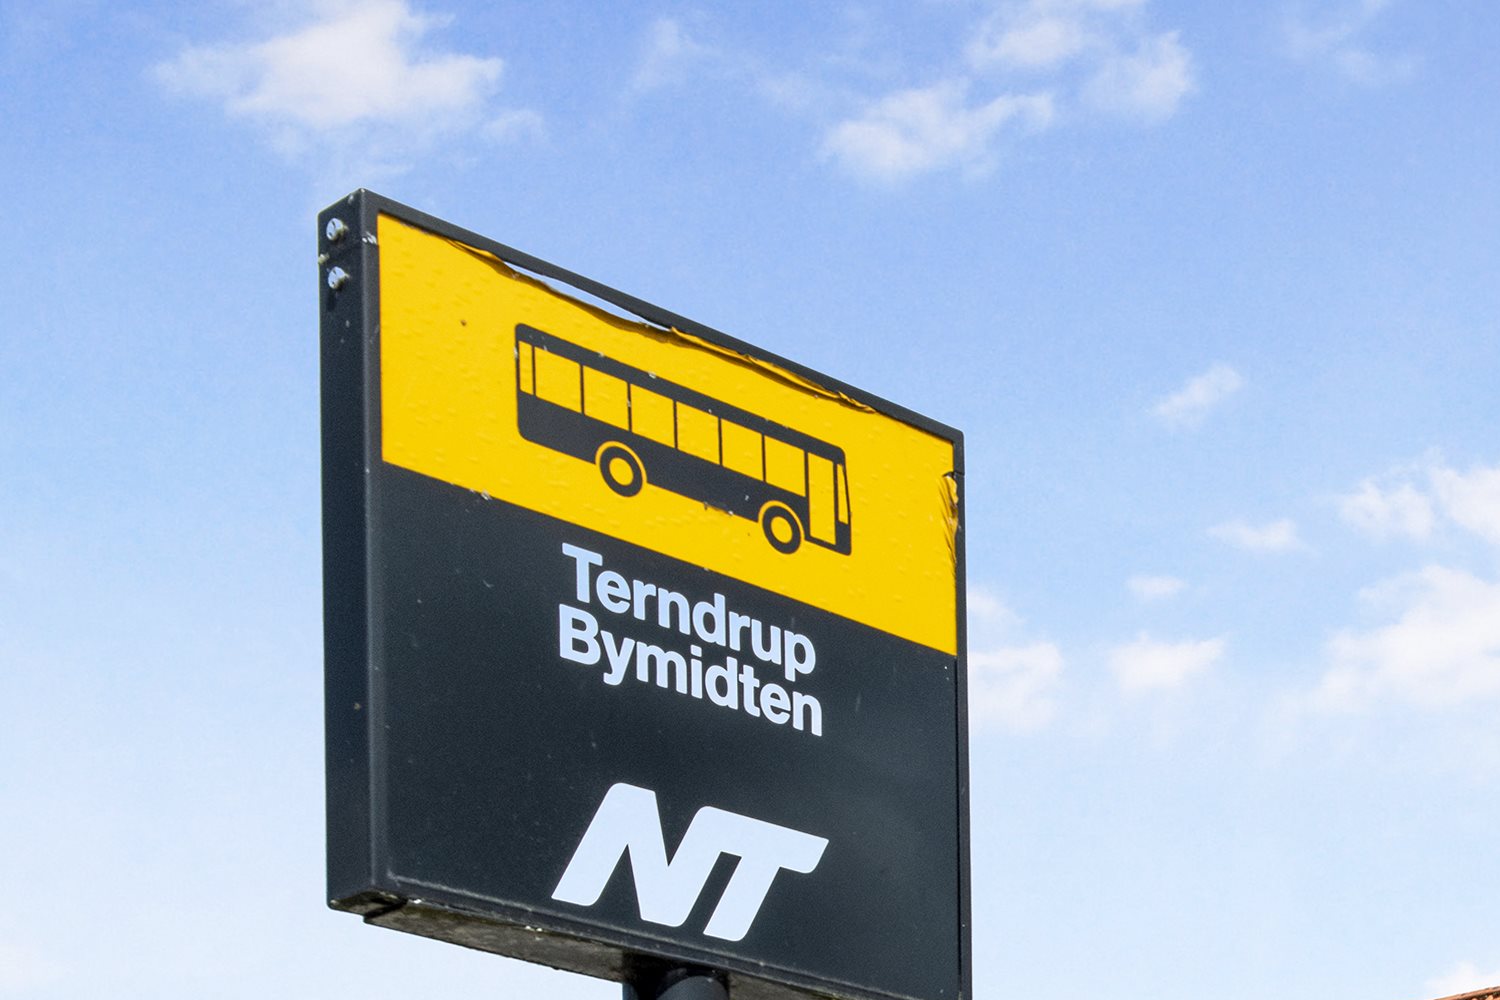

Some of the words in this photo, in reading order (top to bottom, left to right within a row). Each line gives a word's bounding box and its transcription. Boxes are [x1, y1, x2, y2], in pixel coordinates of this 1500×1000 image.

[559, 604, 822, 736] Bymidten
[562, 542, 816, 682] Terndrup
[551, 782, 829, 941] NT
